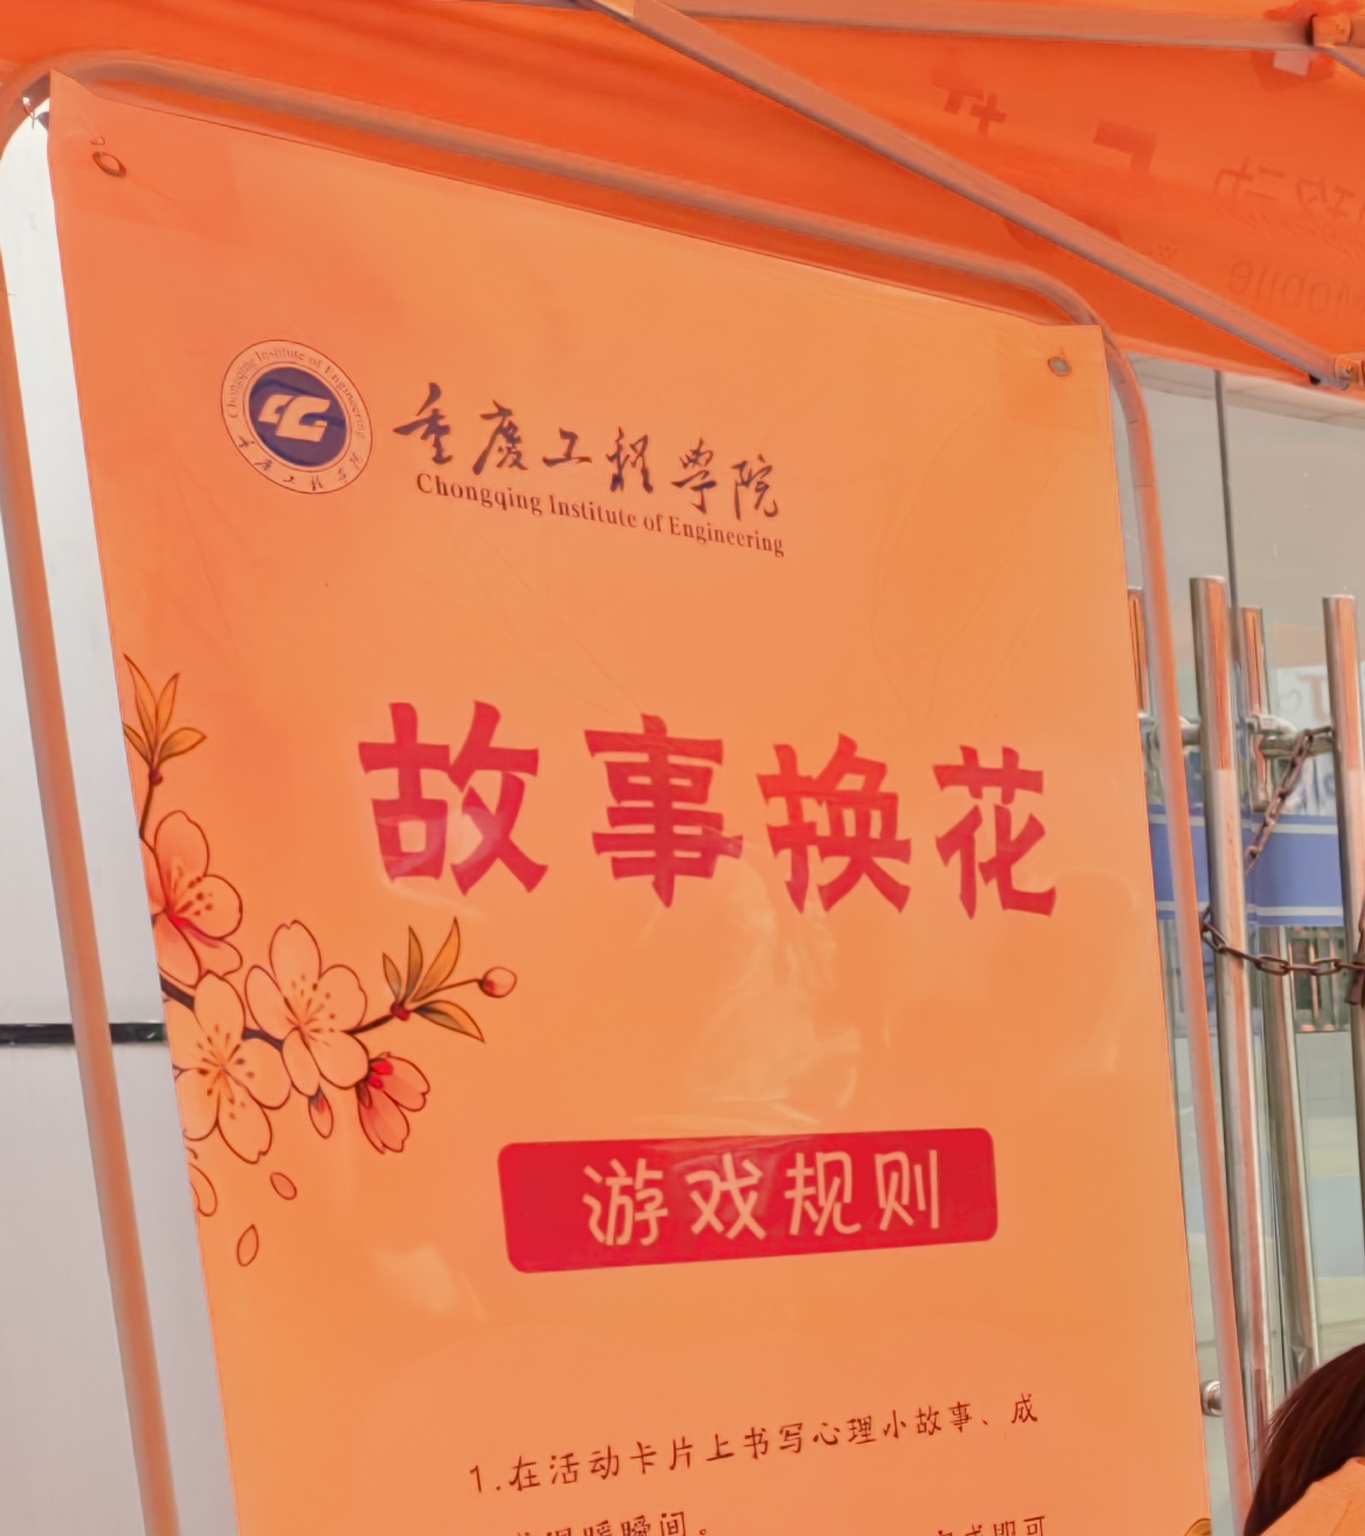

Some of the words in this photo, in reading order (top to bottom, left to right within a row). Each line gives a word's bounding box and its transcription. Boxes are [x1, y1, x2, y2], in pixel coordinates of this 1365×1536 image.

[416, 472, 543, 517] Chongqing
[549, 494, 637, 529] Institute
[643, 514, 663, 534] of
[668, 516, 785, 558] Engineering
[358, 700, 1056, 919] 故事换花
[582, 1148, 941, 1246] 游戏规则
